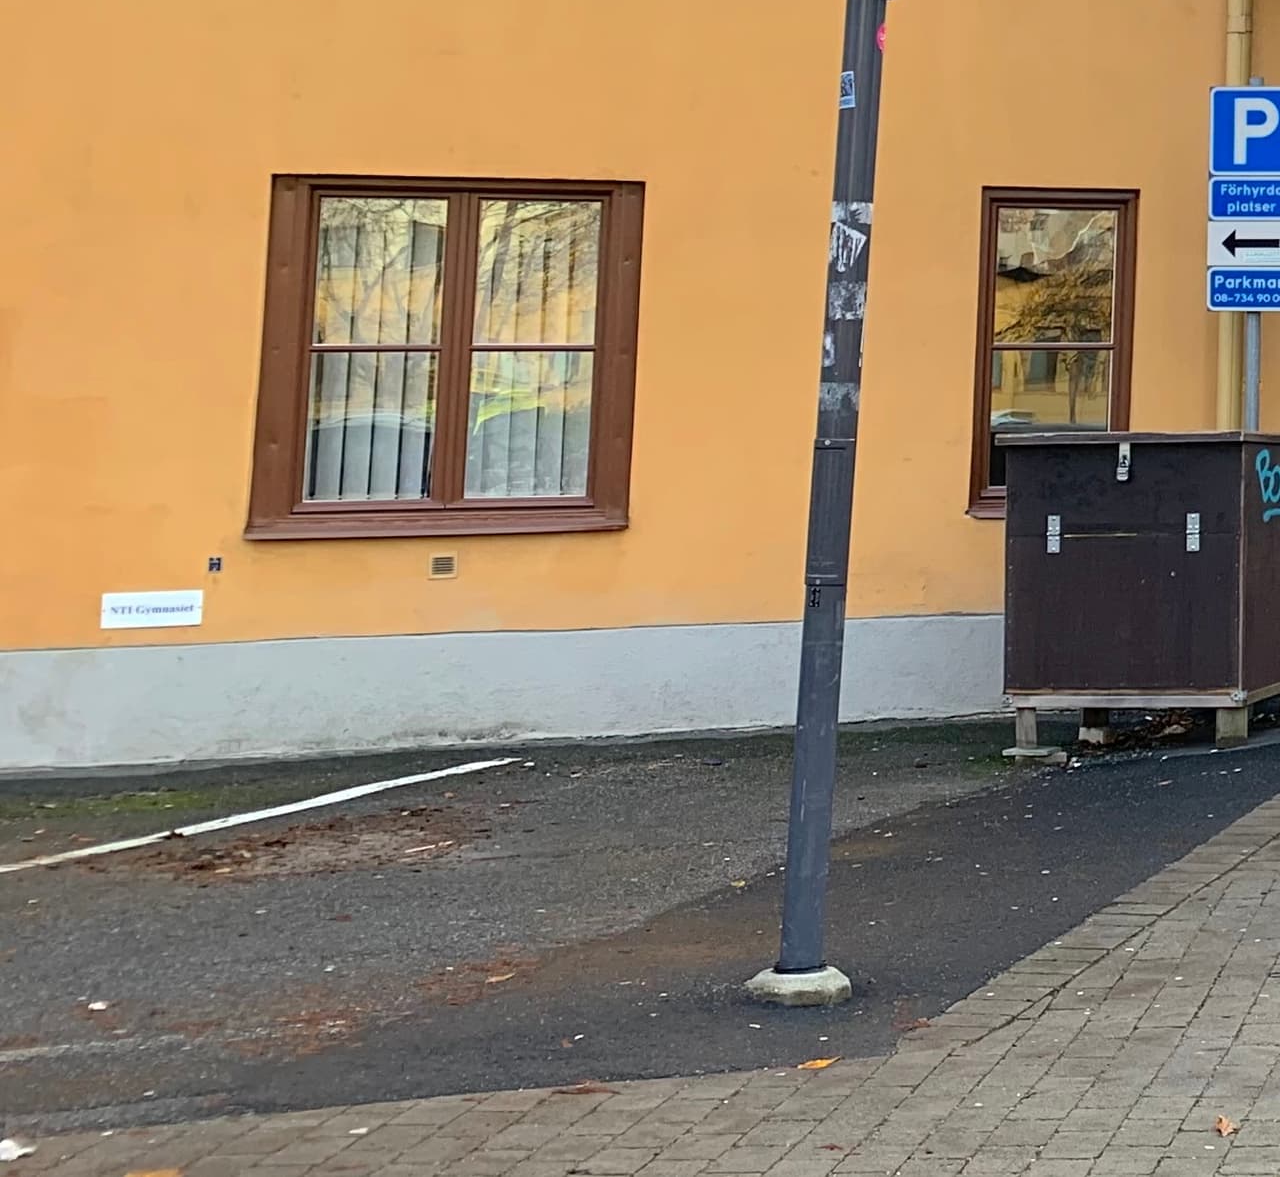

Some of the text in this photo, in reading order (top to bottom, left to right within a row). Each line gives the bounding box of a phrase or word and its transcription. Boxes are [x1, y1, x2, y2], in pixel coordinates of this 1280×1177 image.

[1233, 97, 1280, 165] P
[1227, 200, 1277, 215] platser
[1214, 293, 1254, 303] 08-734
[110, 603, 195, 617] NTI Gymnasiet
